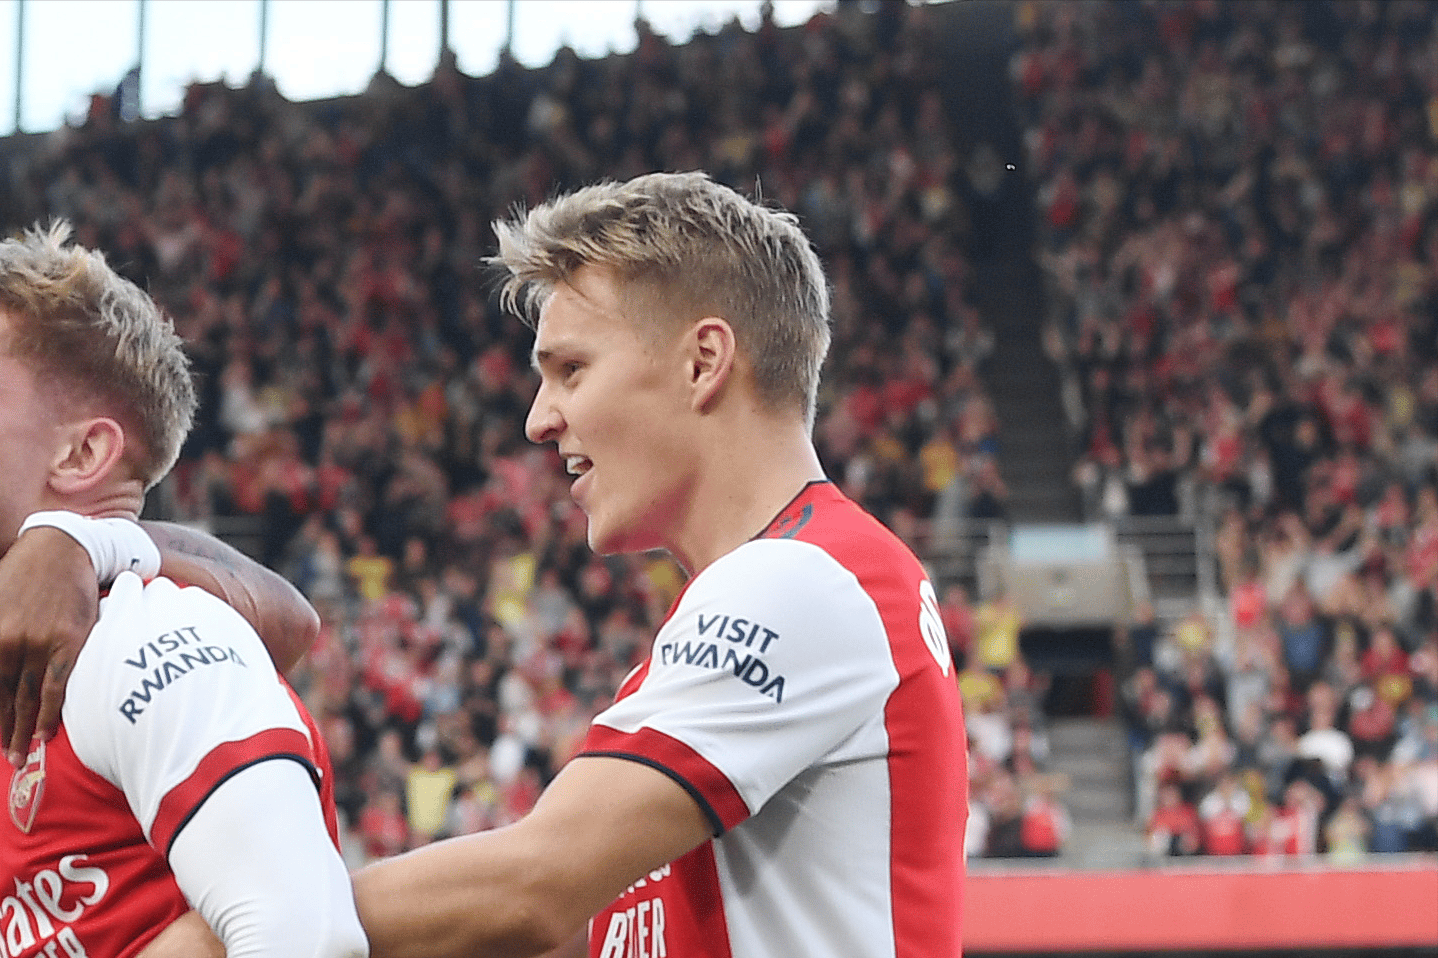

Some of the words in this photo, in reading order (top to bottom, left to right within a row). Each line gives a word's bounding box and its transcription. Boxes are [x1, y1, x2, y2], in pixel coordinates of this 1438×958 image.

[124, 626, 202, 669] VISIT
[698, 613, 780, 653] VISIT
[119, 645, 248, 724] RWANDA
